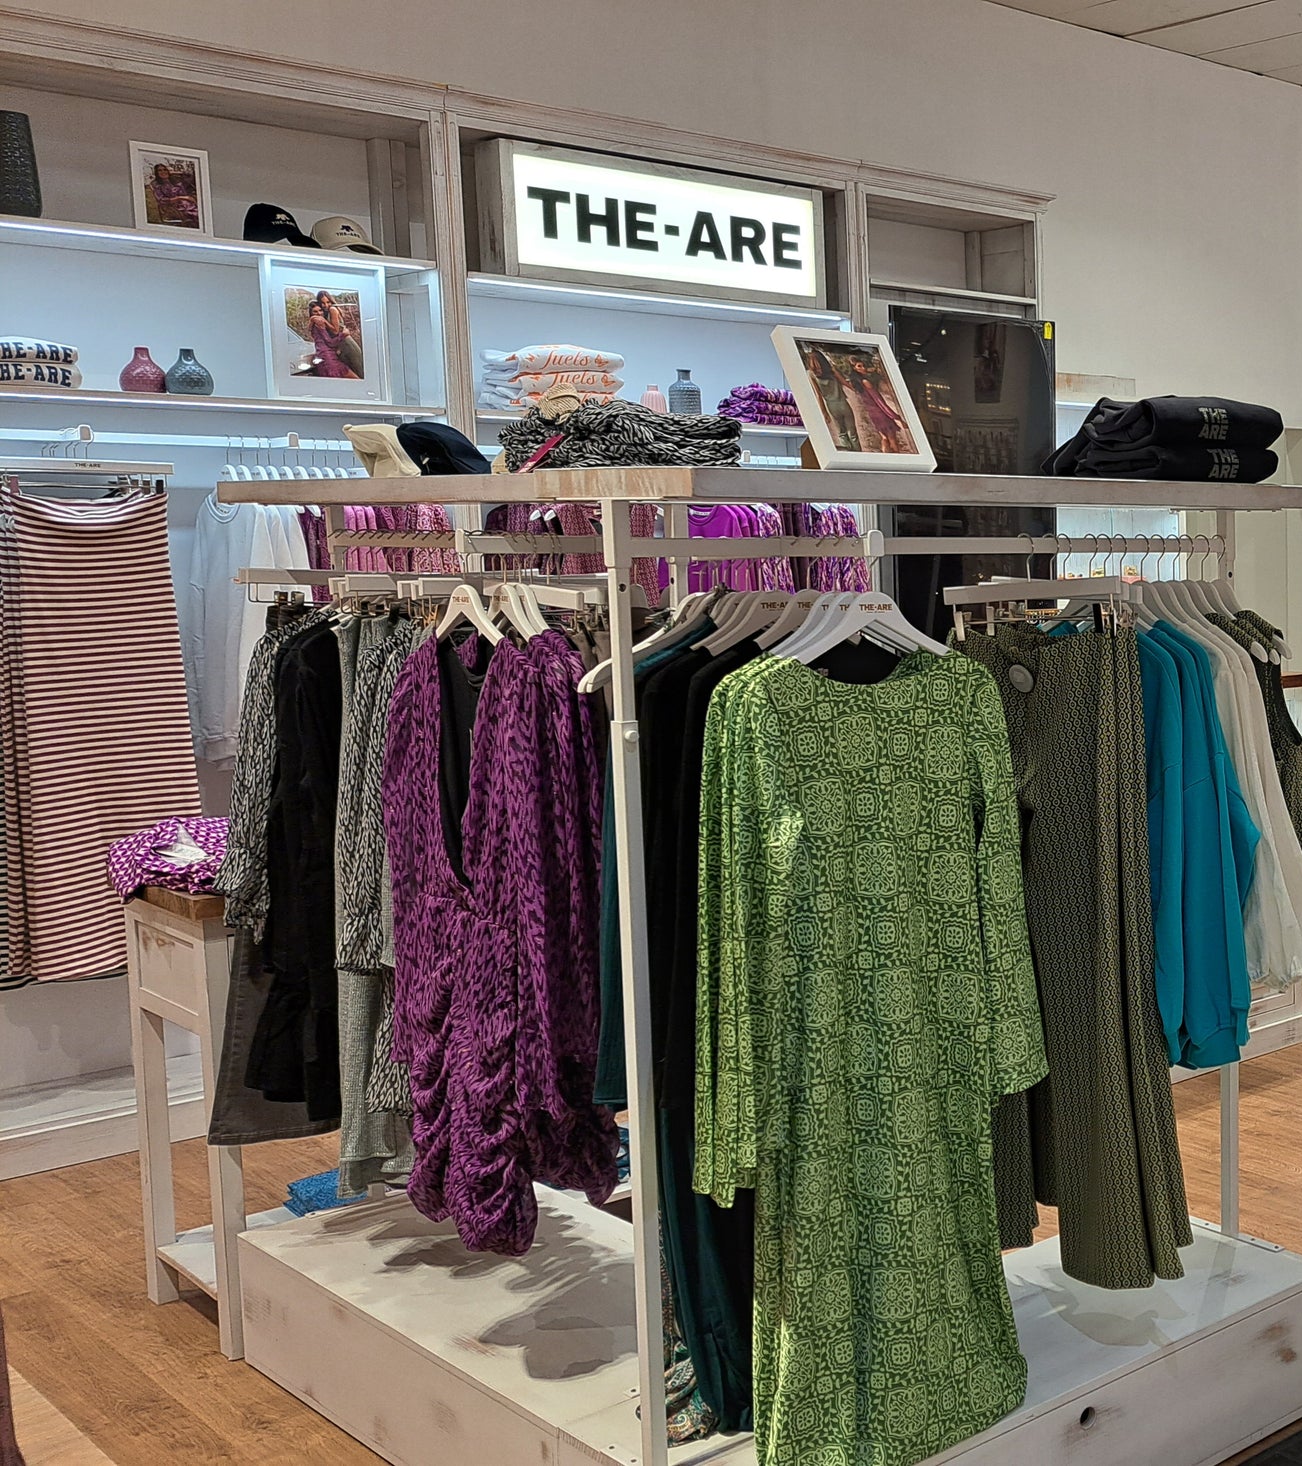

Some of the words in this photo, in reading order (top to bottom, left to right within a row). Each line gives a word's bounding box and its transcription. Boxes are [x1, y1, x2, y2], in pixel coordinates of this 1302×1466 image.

[527, 185, 802, 270] THE-ARE
[0, 342, 75, 364] HE-ARE
[0, 363, 72, 388] HE-ARE
[1198, 407, 1229, 424] THE
[1198, 423, 1229, 440] ARE
[1206, 448, 1240, 464] THE
[1207, 464, 1240, 479] ARE
[859, 603, 893, 611] THE-ARE
